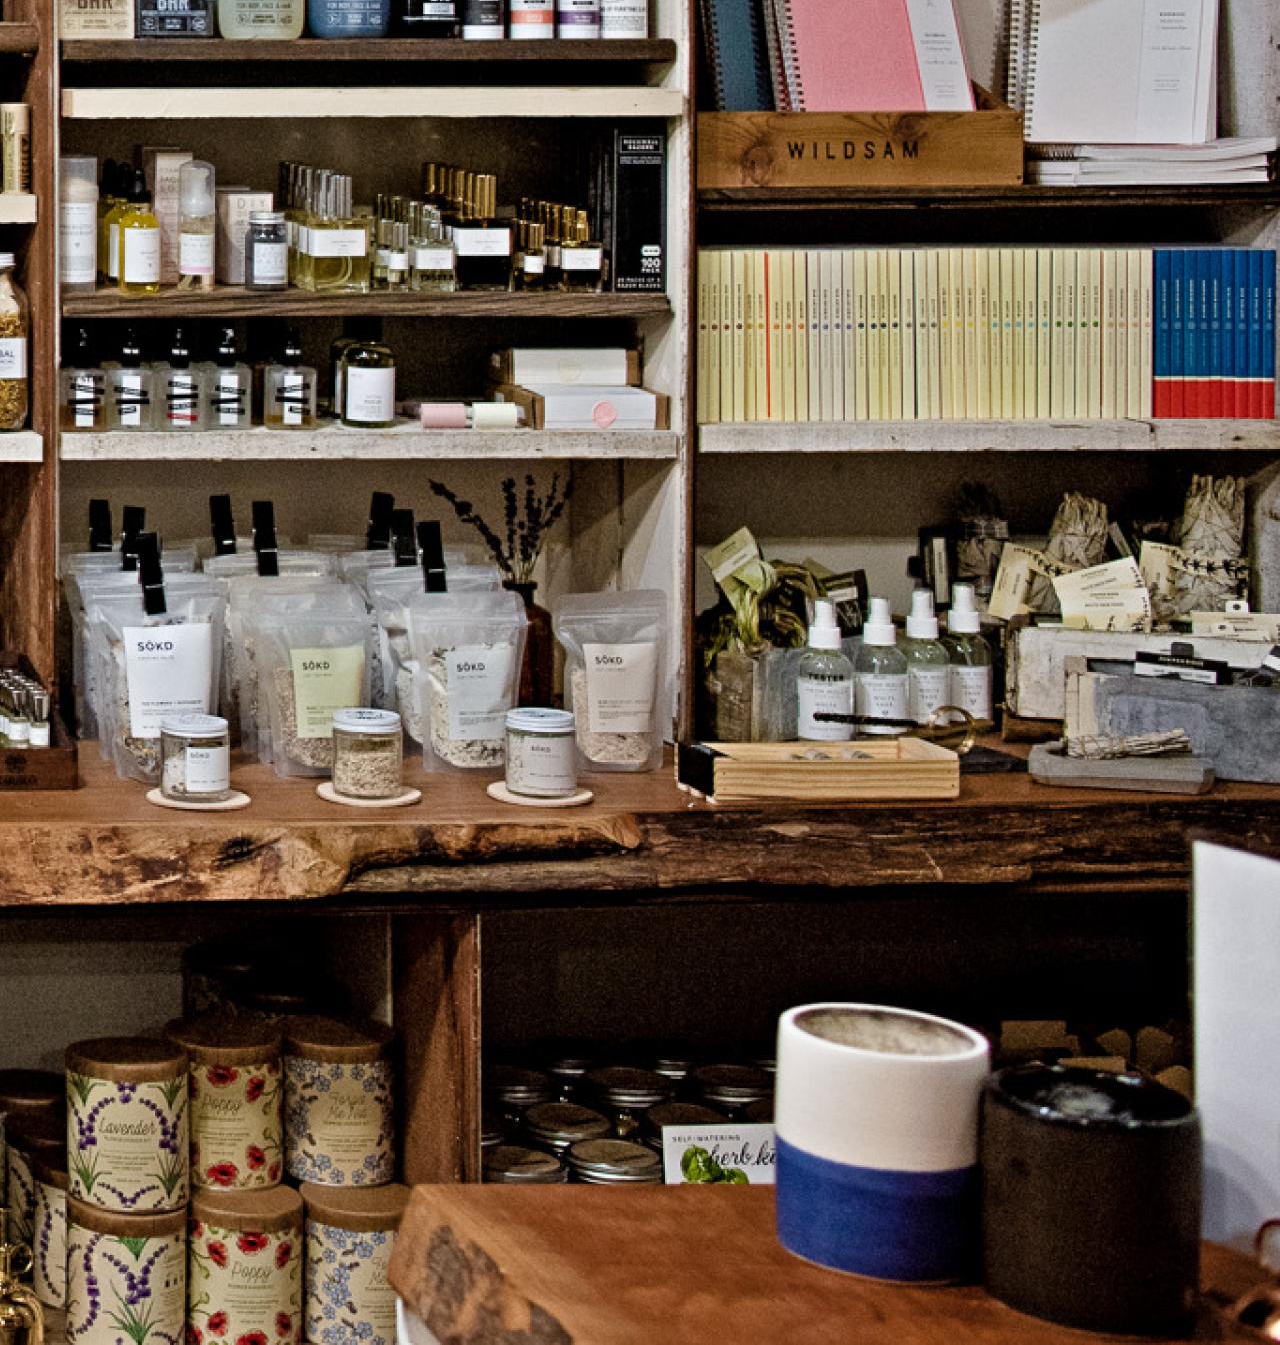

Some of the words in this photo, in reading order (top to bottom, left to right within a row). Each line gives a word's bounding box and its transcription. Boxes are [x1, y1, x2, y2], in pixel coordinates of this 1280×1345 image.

[787, 142, 921, 160] WILDSAM
[808, 673, 844, 682] TESTER
[202, 1093, 243, 1115] Poppy
[98, 1116, 157, 1136] Lavender
[711, 1142, 752, 1166] herb
[231, 1262, 274, 1284] Poppy
